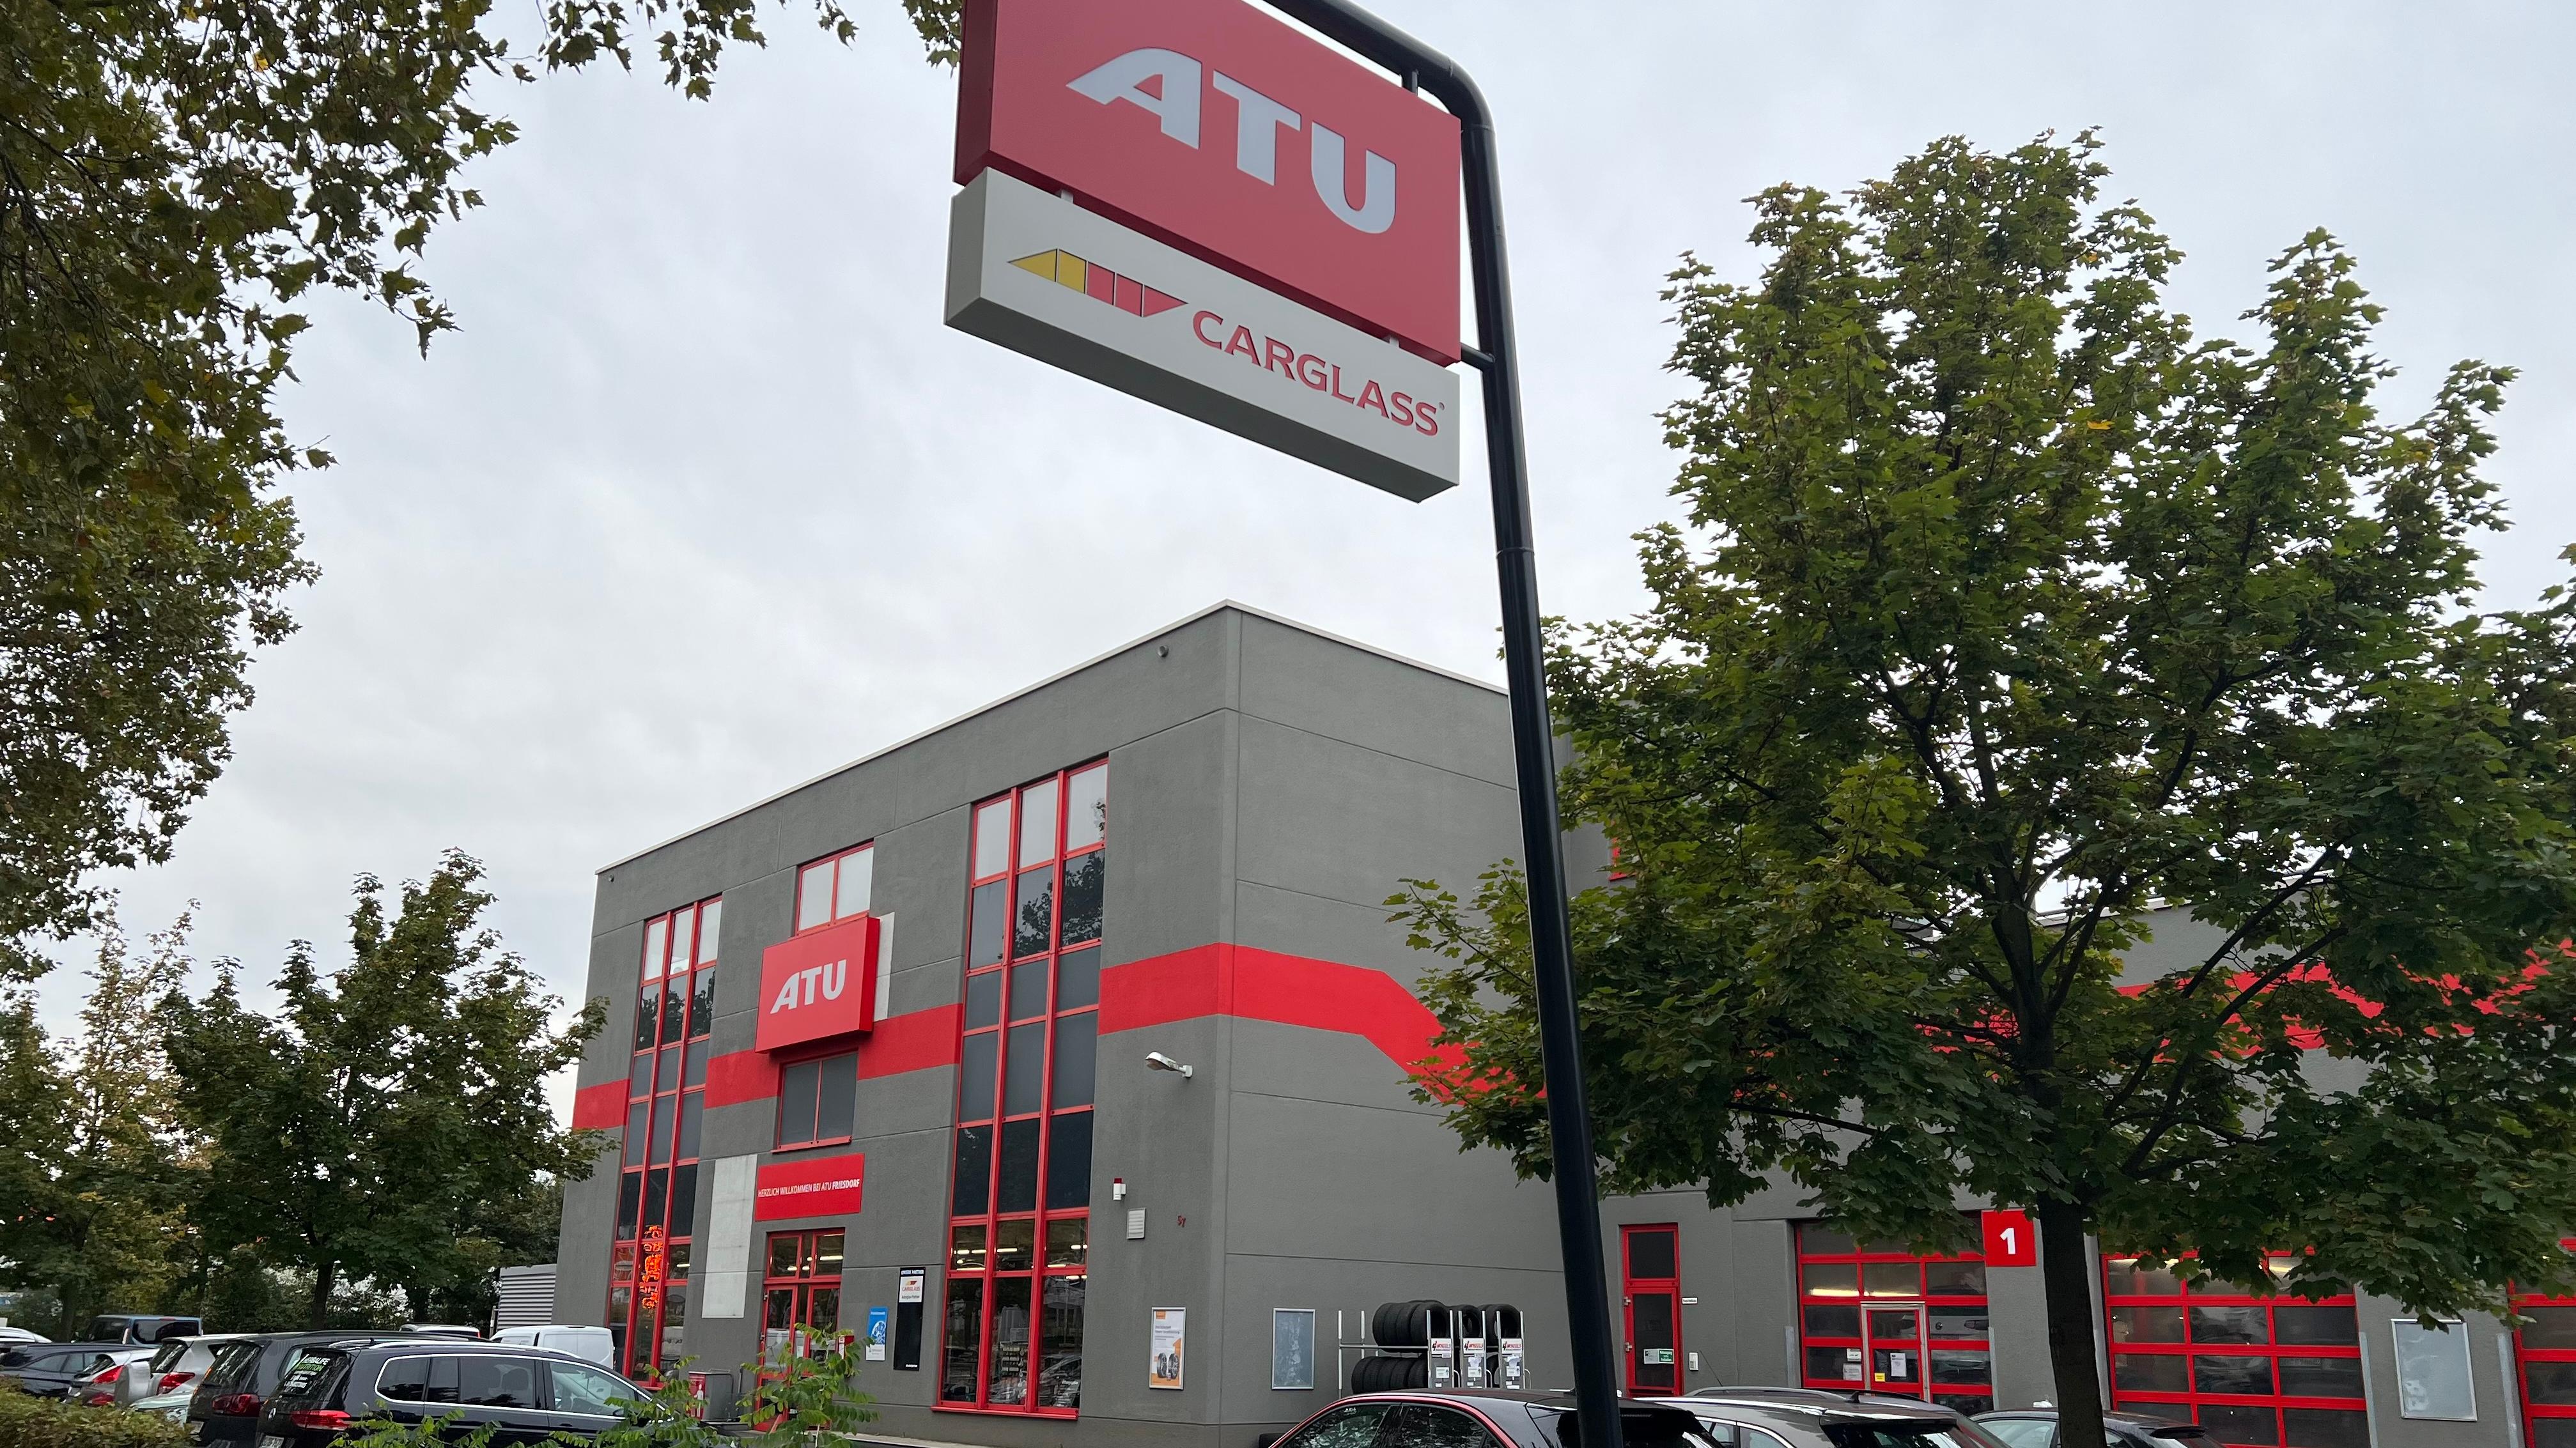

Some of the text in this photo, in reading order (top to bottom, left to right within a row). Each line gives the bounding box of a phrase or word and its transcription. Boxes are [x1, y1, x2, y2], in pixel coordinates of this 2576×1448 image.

[1066, 47, 1396, 234] ATU
[771, 959, 846, 1014] ATU
[758, 1187, 779, 1198] HERZLICH
[780, 1183, 812, 1194] WILLKOMMEN
[821, 1181, 832, 1191] ATU
[832, 1179, 860, 1190] FRIESDORF
[1999, 1228, 2016, 1255] 1
